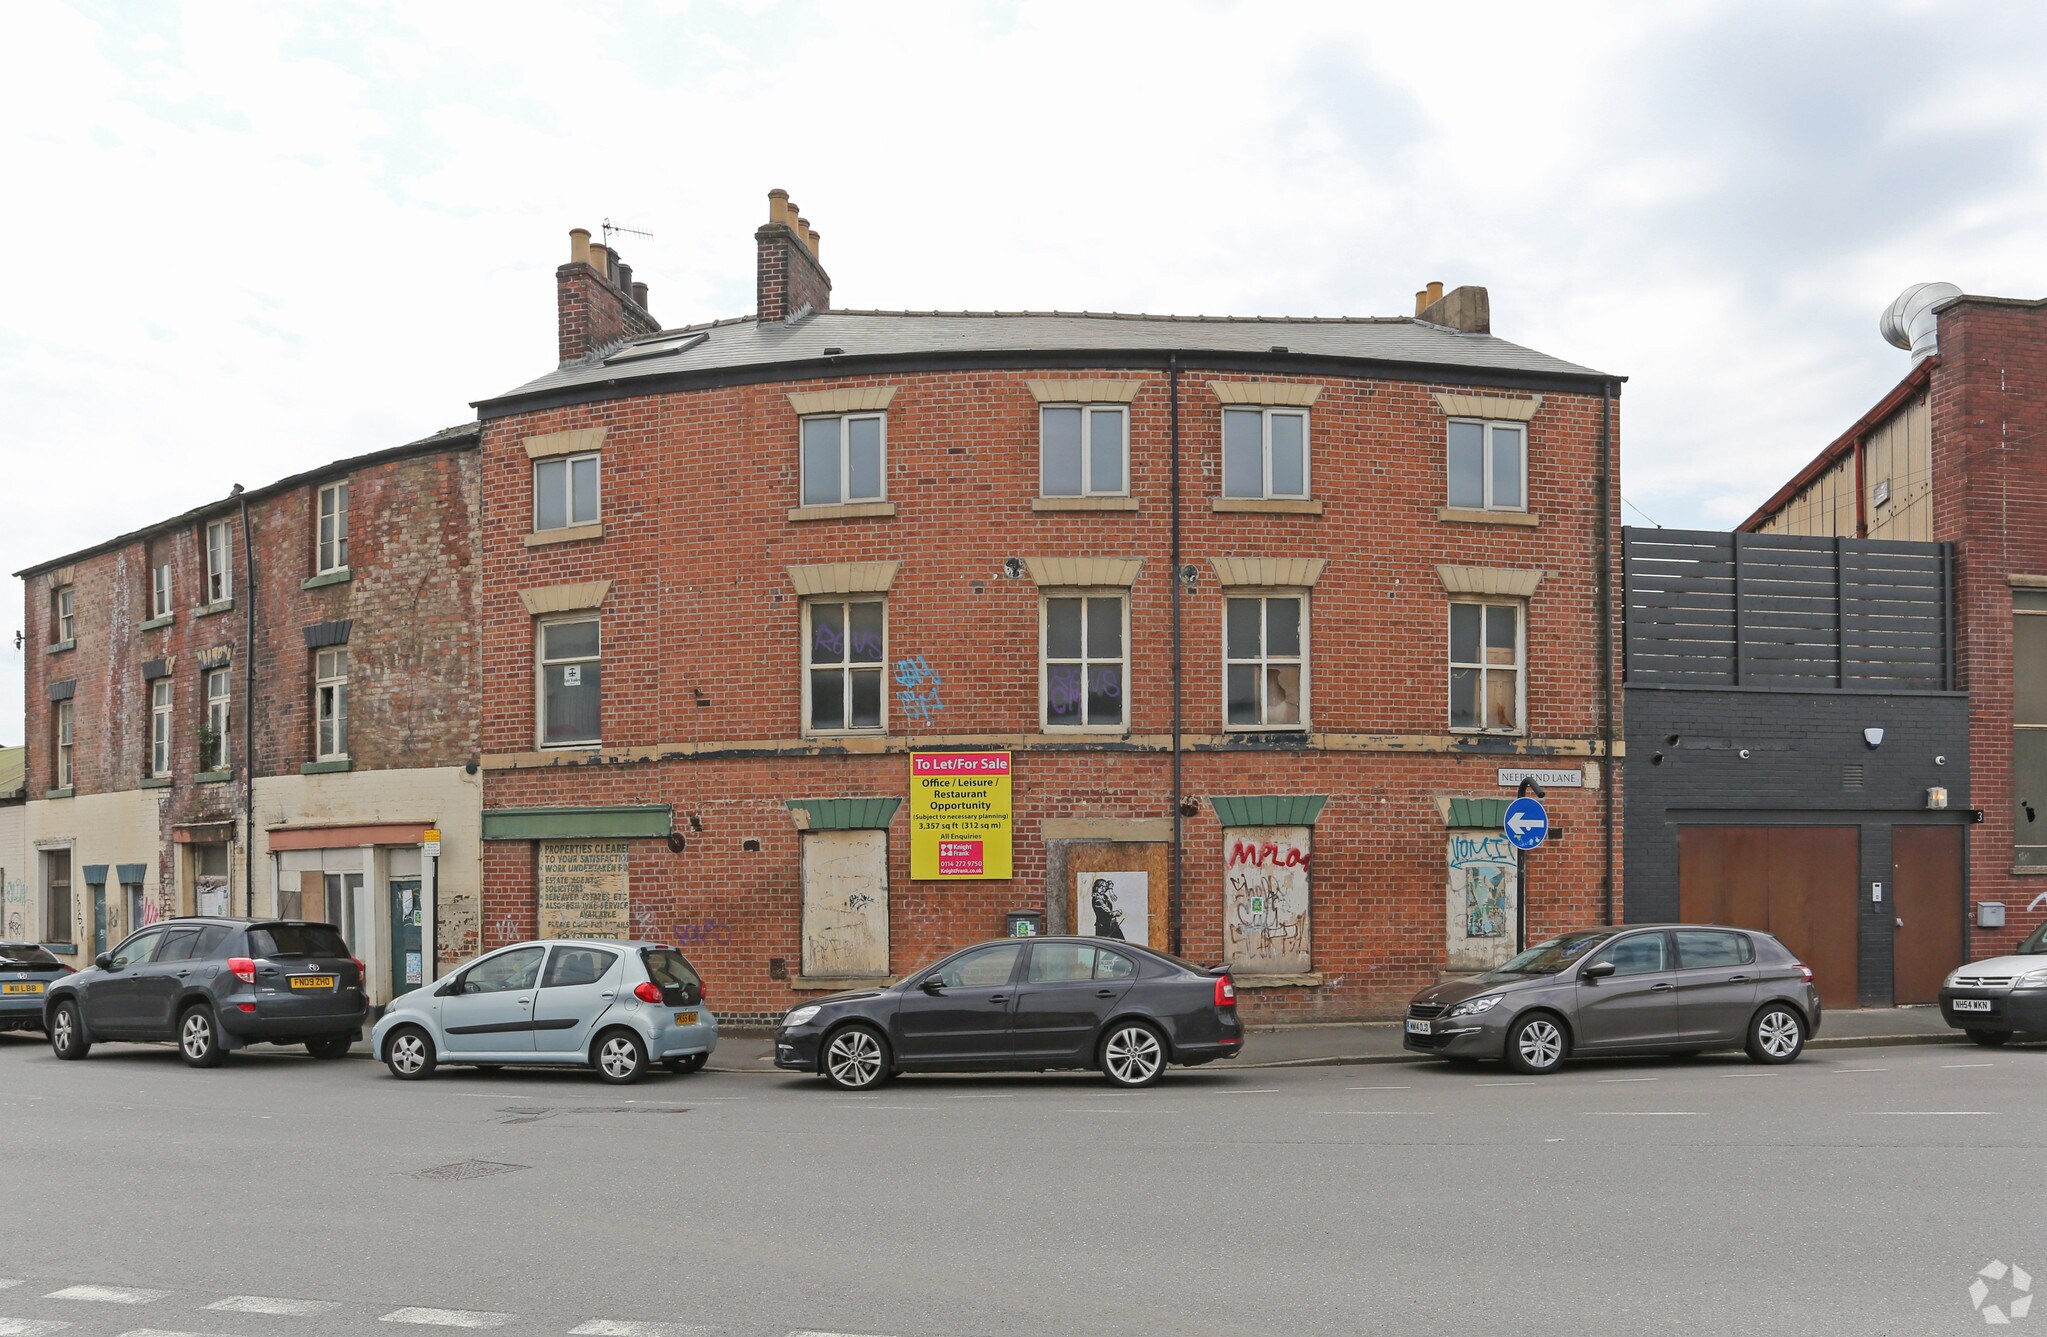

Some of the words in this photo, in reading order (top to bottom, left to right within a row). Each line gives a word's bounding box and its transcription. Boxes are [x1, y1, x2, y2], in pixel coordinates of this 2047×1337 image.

[915, 758, 930, 770] To
[933, 758, 978, 770] Let/For
[980, 758, 1008, 769] Sale
[922, 778, 950, 787] Office
[952, 778, 956, 787] /
[958, 777, 993, 787] Leisure
[995, 778, 1000, 786] /
[1552, 774, 1576, 783] LANE
[934, 790, 987, 798] Restaurant
[930, 801, 991, 811] Opportunity
[1977, 811, 1983, 822] 3
[545, 845, 592, 854] PROPERTIES
[557, 855, 578, 863] YOUR
[1955, 1001, 1972, 1009] NH54
[1973, 1001, 1988, 1009] WKN
